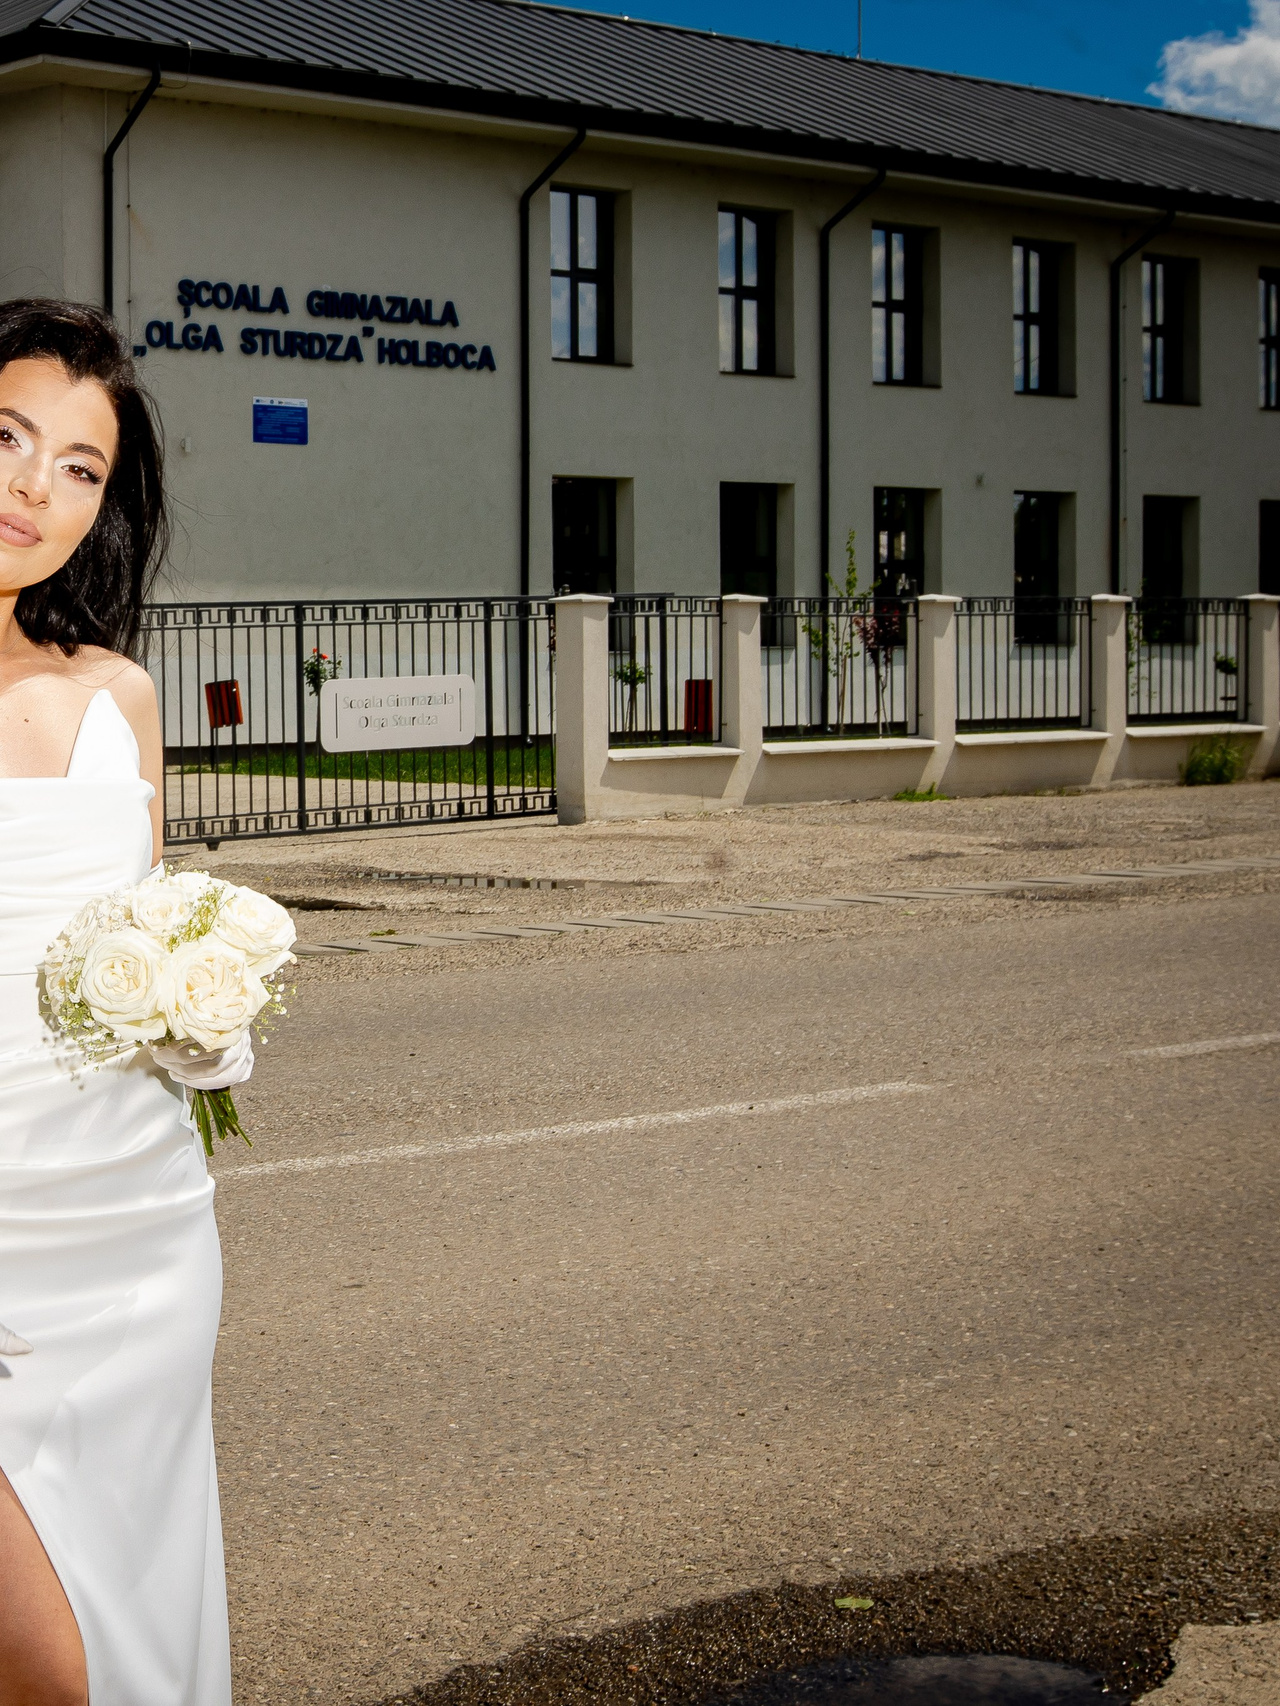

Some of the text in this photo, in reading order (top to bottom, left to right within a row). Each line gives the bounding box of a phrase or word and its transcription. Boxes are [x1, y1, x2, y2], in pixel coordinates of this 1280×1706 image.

[306, 290, 459, 327] GIMNAZIALA
[377, 337, 496, 371] HOLBOCA
[358, 715, 388, 732] Olga
